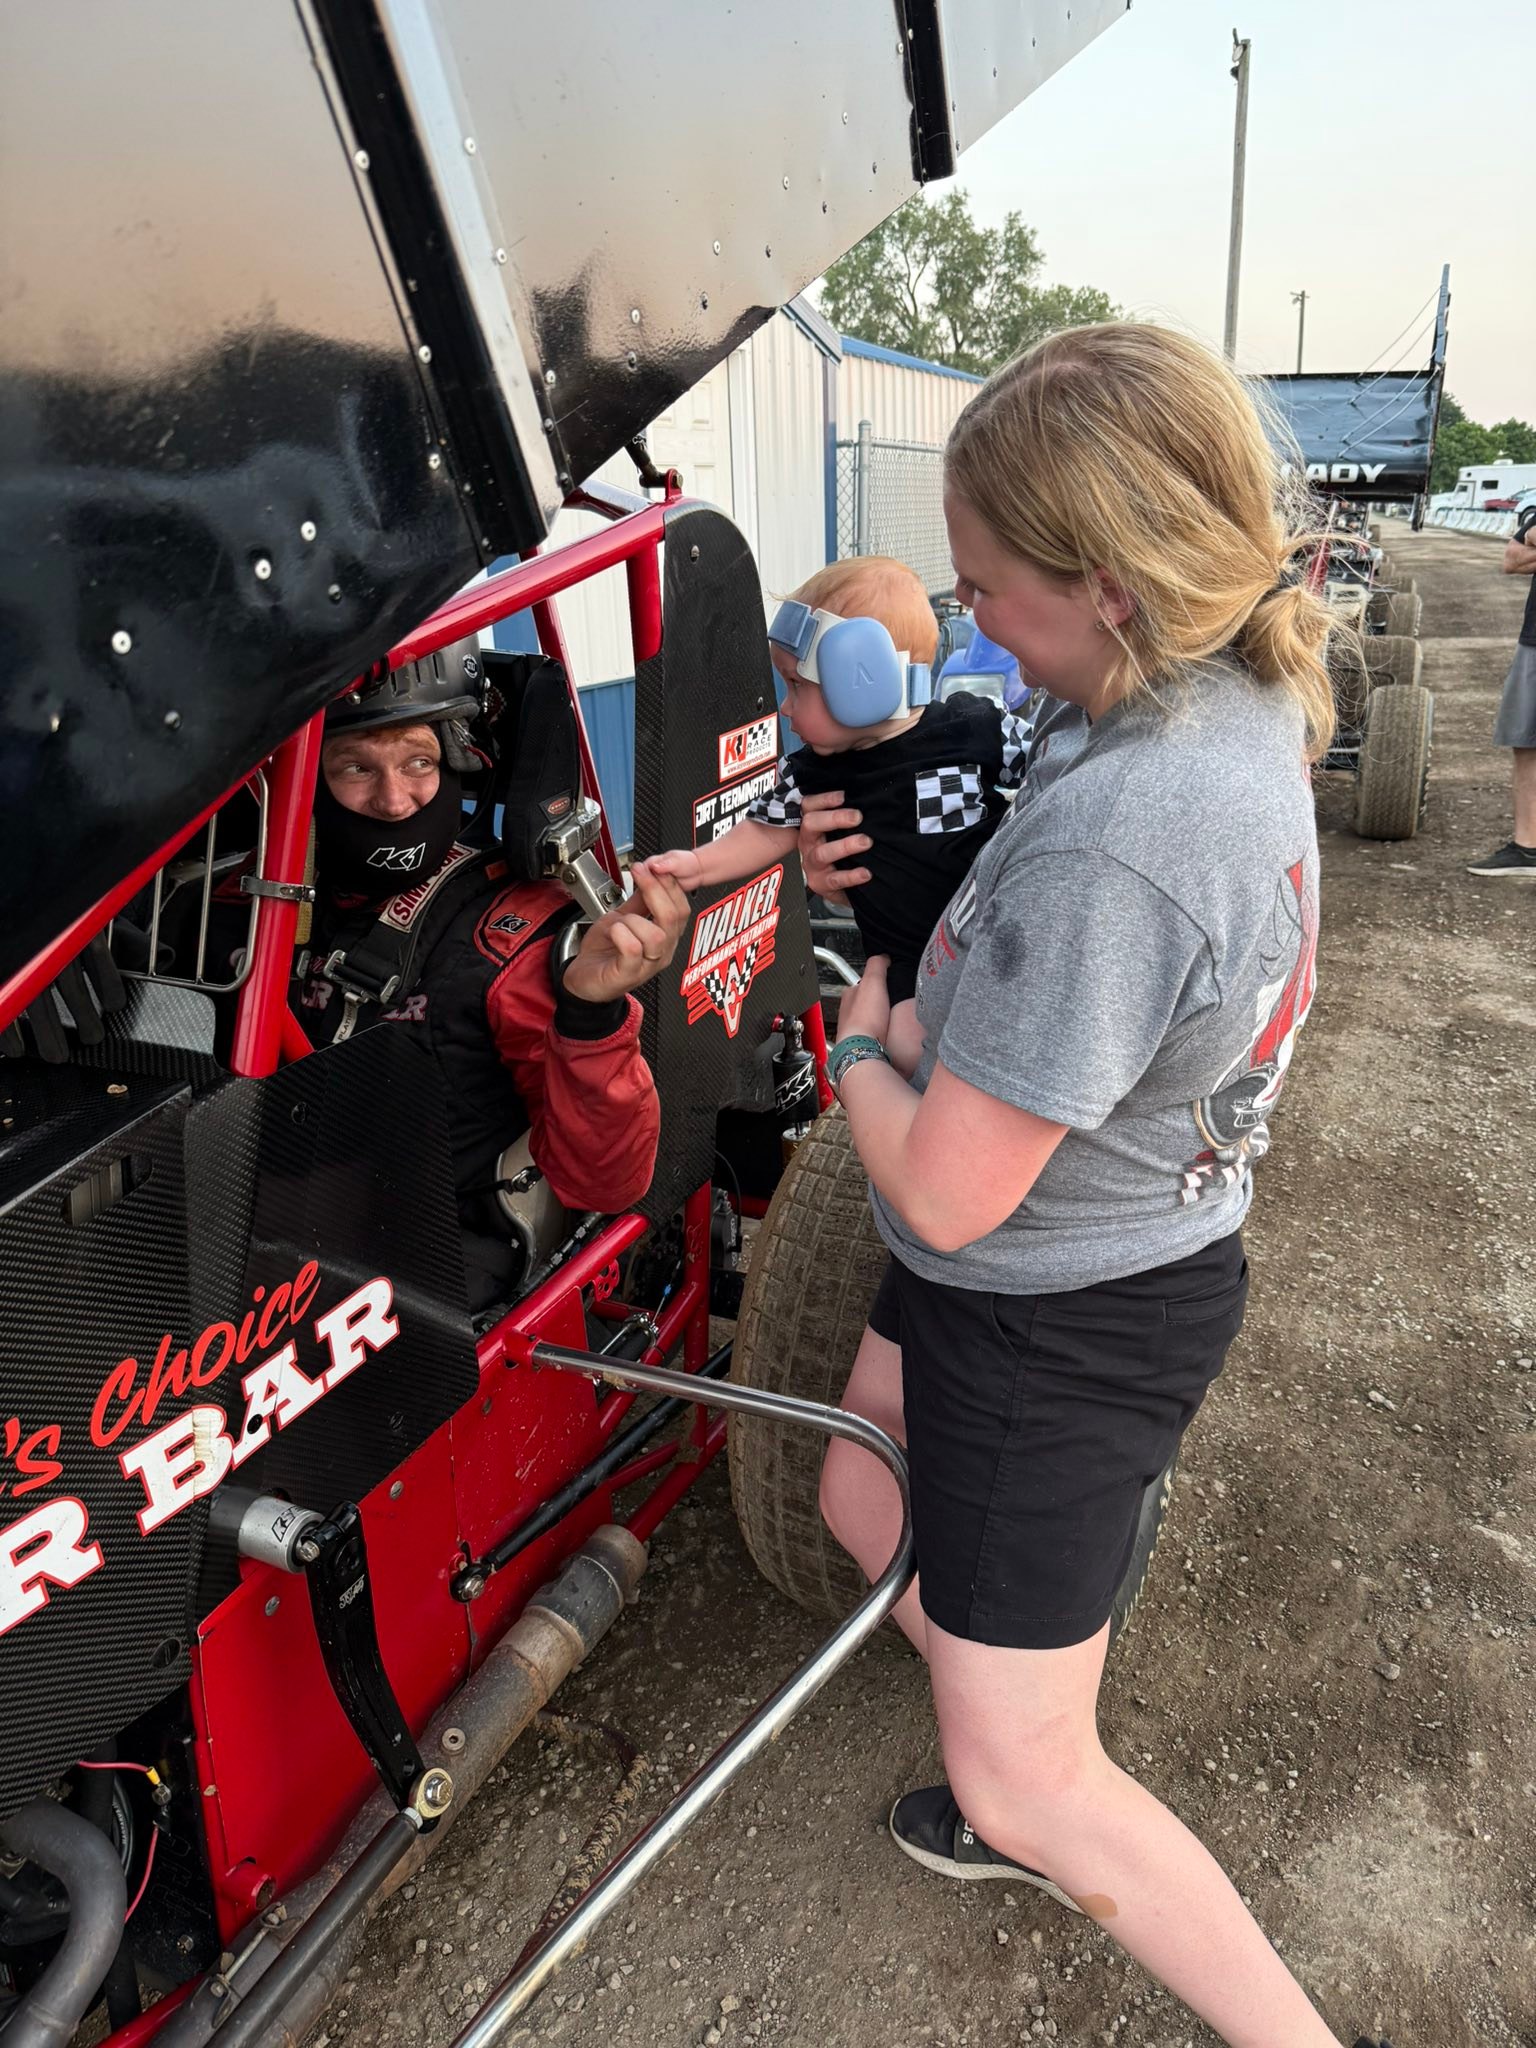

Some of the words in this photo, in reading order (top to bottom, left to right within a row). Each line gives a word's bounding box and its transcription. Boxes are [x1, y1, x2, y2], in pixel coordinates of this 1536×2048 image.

[747, 734, 772, 750] RACE
[747, 742, 771, 755] PRODUCTS
[682, 940, 739, 991] PERFORMANCE
[740, 911, 779, 951] FILTRATION
[690, 869, 782, 967] WALKER
[90, 1260, 322, 1447] Choice
[118, 1276, 400, 1536] BAR
